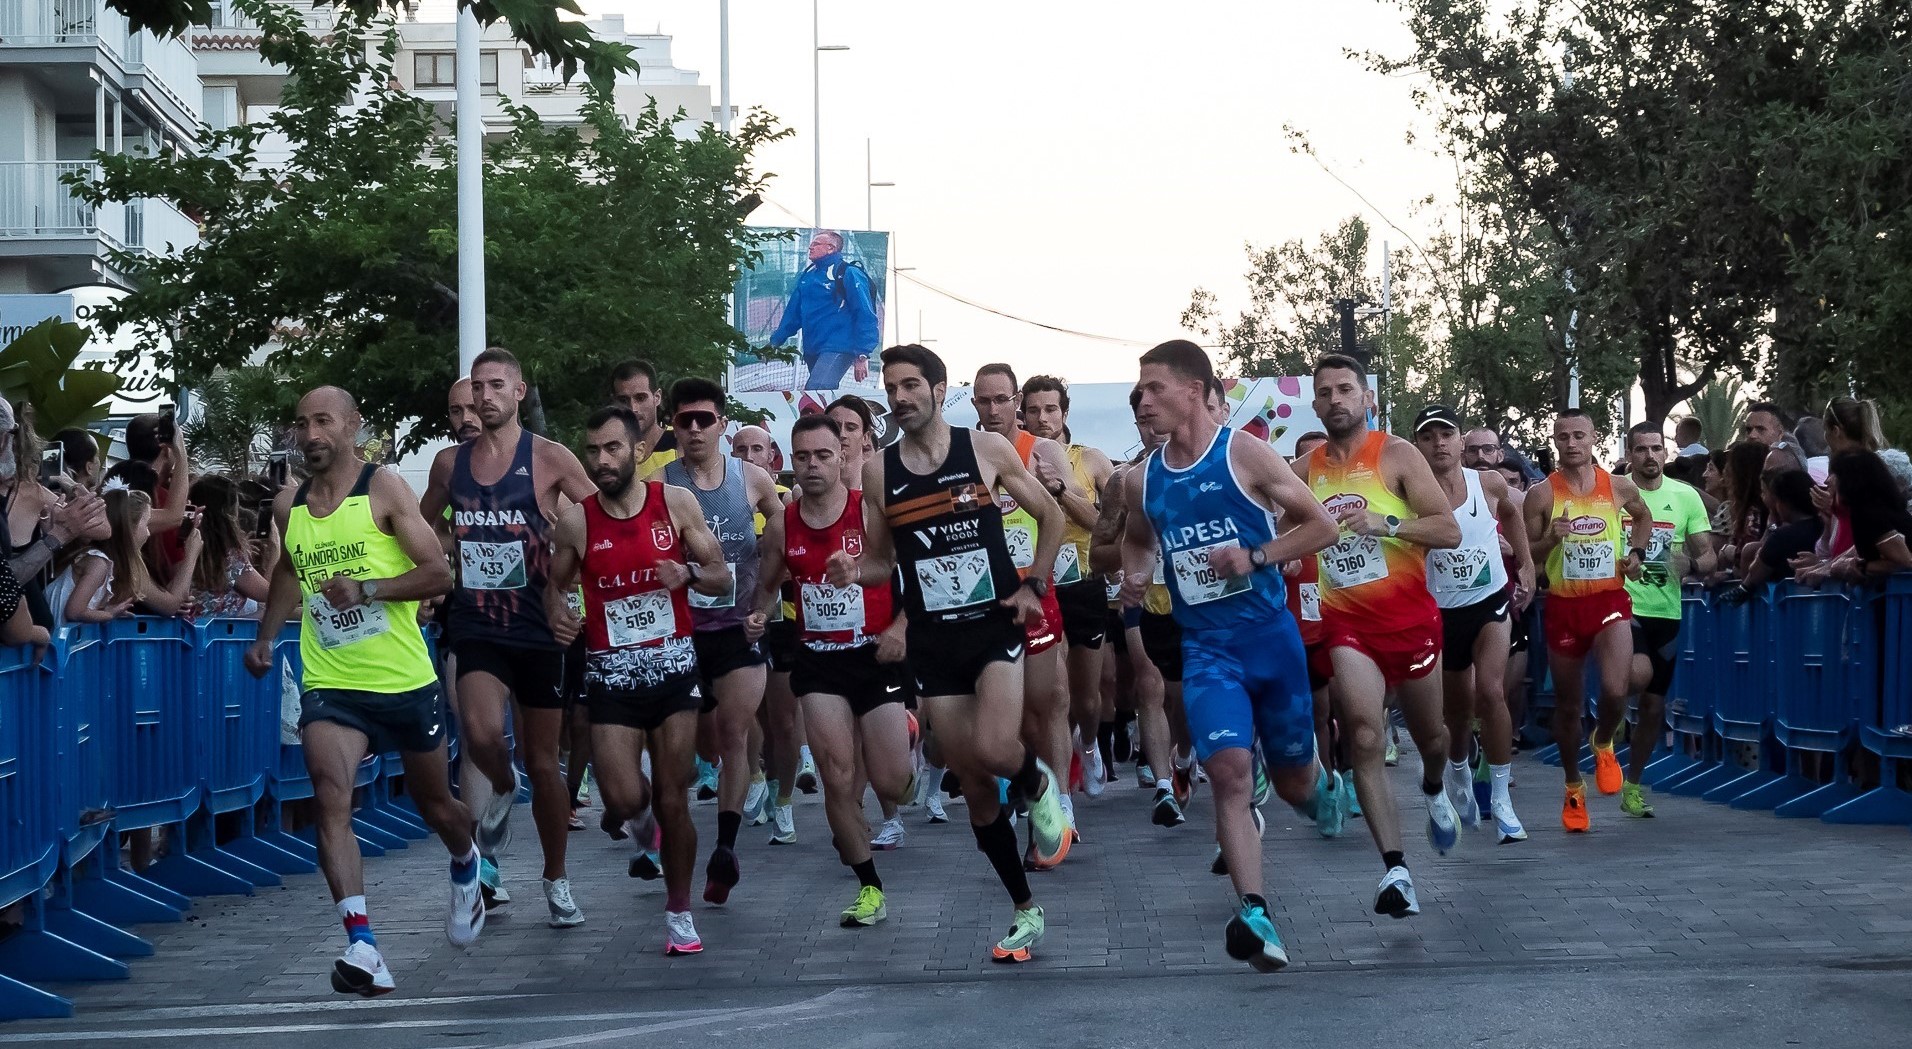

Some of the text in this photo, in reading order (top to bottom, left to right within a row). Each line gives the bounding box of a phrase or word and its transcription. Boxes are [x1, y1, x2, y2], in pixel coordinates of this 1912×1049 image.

[1325, 500, 1363, 515] errano
[455, 510, 526, 526] ROSANA
[1572, 521, 1604, 531] Serrano
[940, 519, 979, 534] VICKY
[1162, 516, 1238, 552] ALPESA
[946, 530, 979, 541] FOODS
[340, 541, 368, 560] SANZ
[480, 562, 504, 576] 433
[967, 554, 985, 575] 23
[1336, 554, 1366, 573] 5160
[1579, 557, 1601, 568] 5167
[1194, 567, 1226, 586] 109
[1452, 565, 1473, 579] 587
[598, 573, 626, 589] C.A.
[950, 575, 961, 591] 3
[816, 602, 847, 617] 5052
[330, 608, 365, 630] 5001
[625, 610, 656, 629] 5158
